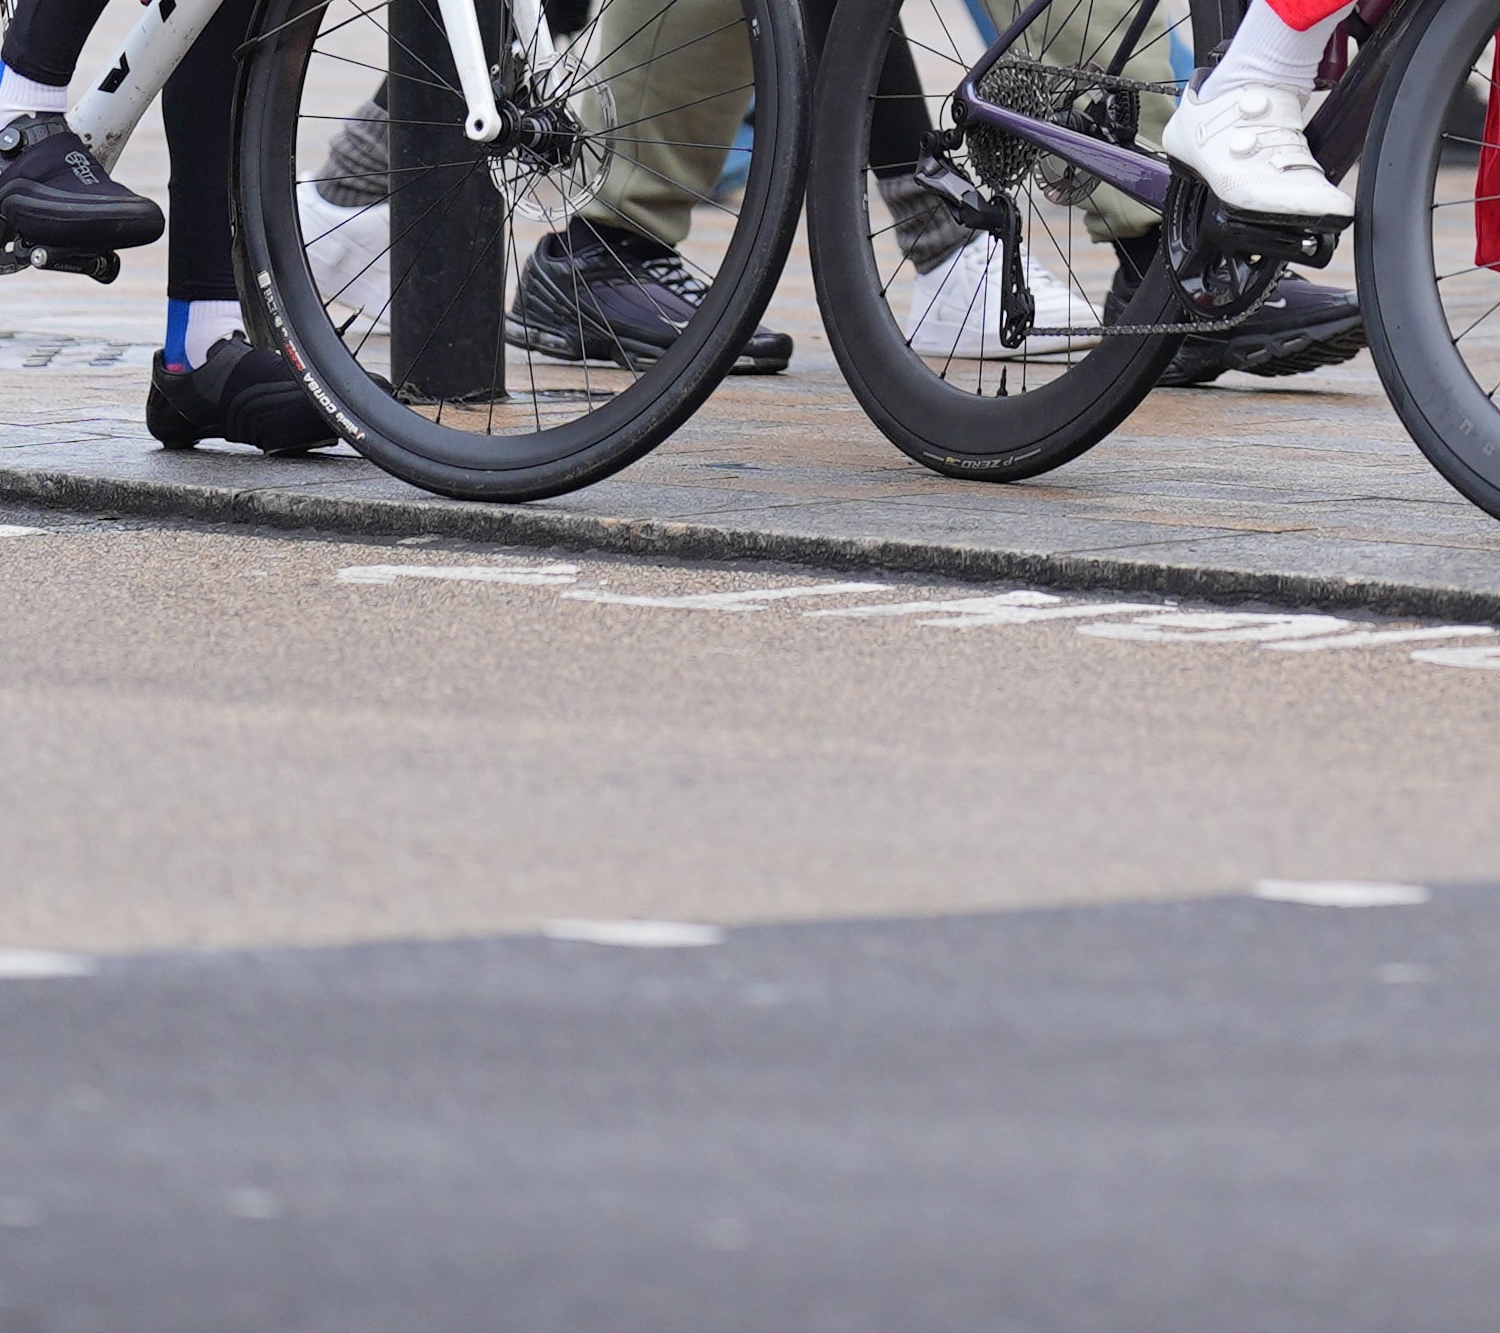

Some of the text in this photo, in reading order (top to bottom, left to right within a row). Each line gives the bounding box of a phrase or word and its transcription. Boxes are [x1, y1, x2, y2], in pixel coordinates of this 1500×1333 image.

[303, 372, 338, 414] CORSA
[960, 458, 1002, 470] ZERO
[1002, 455, 1014, 467] P
